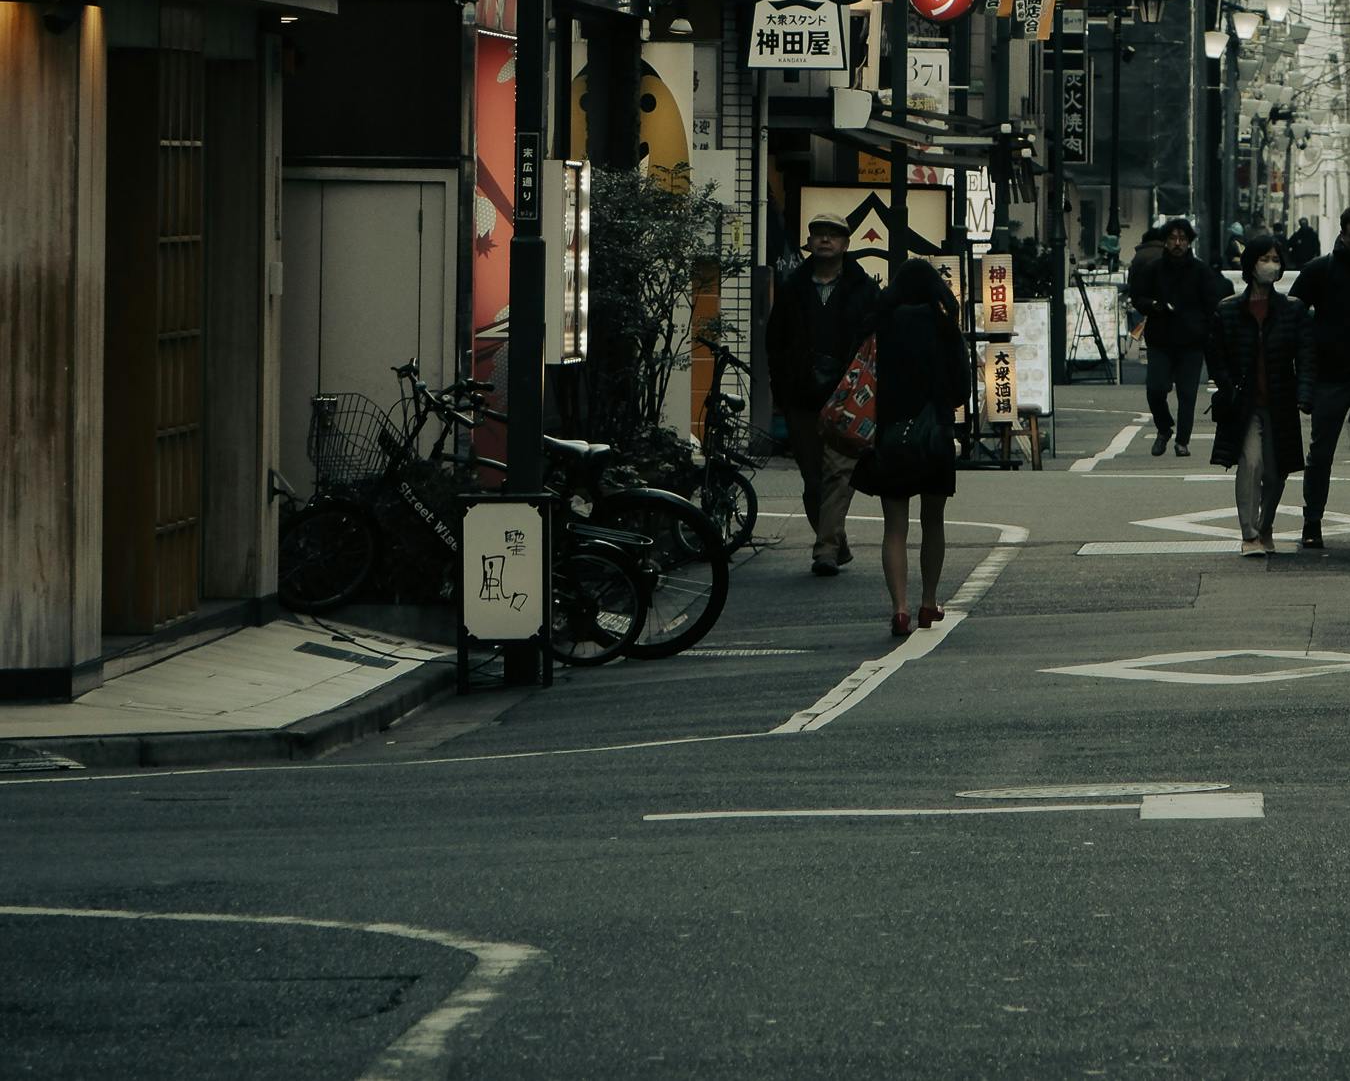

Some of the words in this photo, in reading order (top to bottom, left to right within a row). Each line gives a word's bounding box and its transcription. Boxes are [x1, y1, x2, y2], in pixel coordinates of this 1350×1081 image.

[766, 14, 827, 26] 大衆スタンド
[756, 29, 831, 56] 神田屋
[522, 147, 534, 202] 末広通り
[988, 265, 1008, 323] 神田屋
[400, 481, 435, 523] Street
